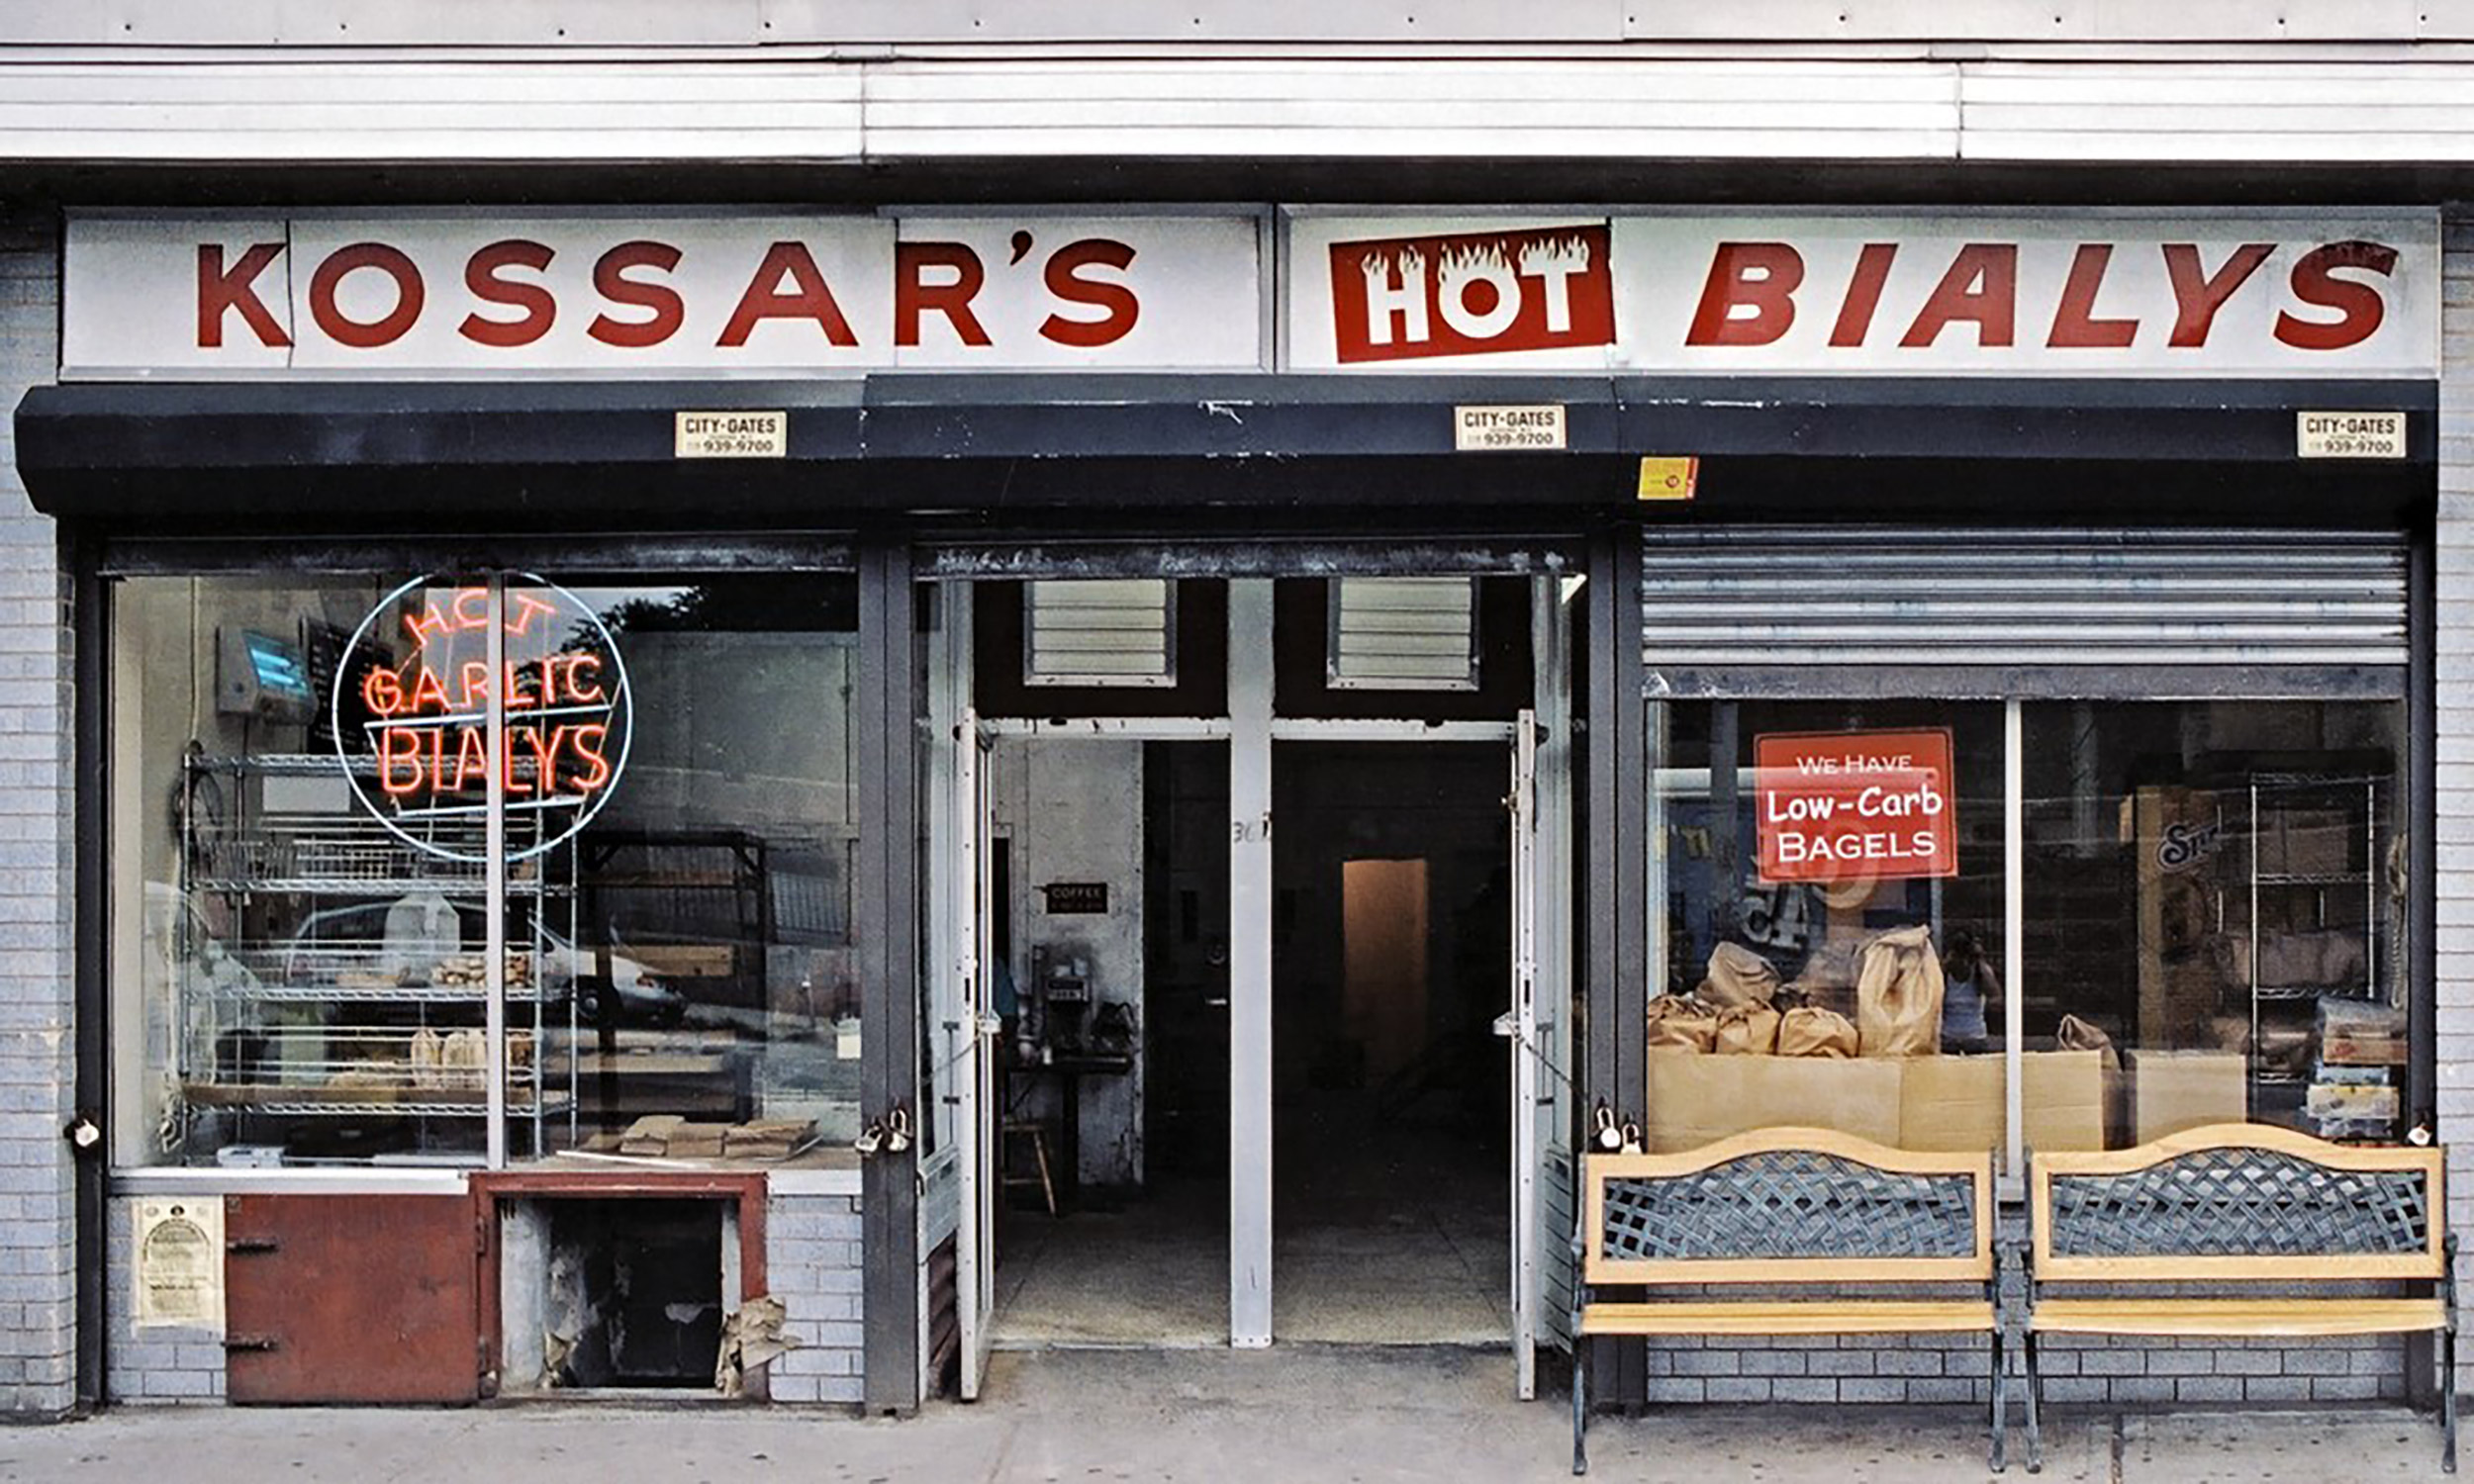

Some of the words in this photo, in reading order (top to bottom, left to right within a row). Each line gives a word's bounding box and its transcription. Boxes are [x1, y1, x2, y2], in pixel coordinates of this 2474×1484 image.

[198, 231, 1139, 348] KOSSAR'S
[1362, 235, 1589, 344] HOT
[1685, 240, 2399, 349] BIALYS
[404, 588, 556, 645] HOT
[364, 655, 600, 715] GARLIC
[381, 723, 610, 793] BIALYS
[1766, 783, 1944, 823] Low-Carb
[1776, 830, 1937, 864] BAGELS
